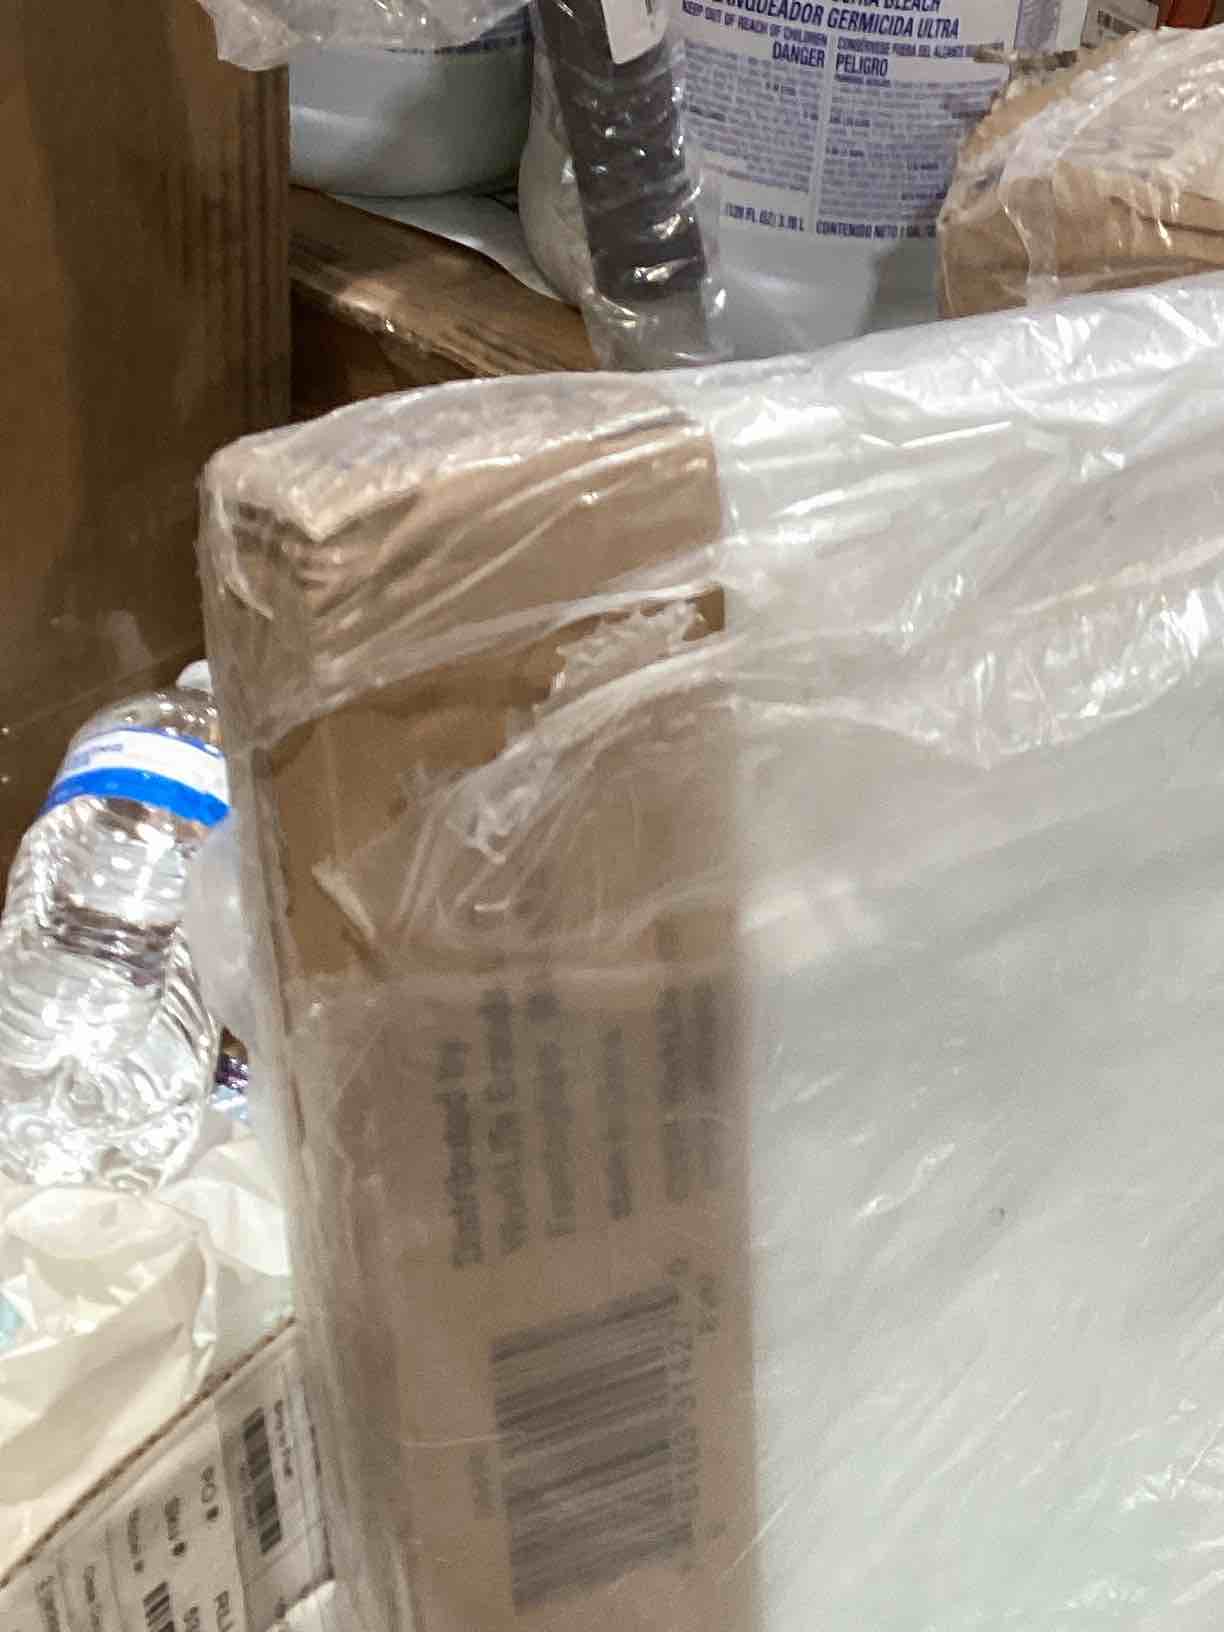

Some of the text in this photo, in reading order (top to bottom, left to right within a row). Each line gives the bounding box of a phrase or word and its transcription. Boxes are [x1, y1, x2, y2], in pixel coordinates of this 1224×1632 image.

[827, 7, 914, 37] GERMICIDA
[917, 17, 960, 39] ULTRA
[772, 40, 825, 68] DANGER
[836, 52, 889, 77] PELIGRO
